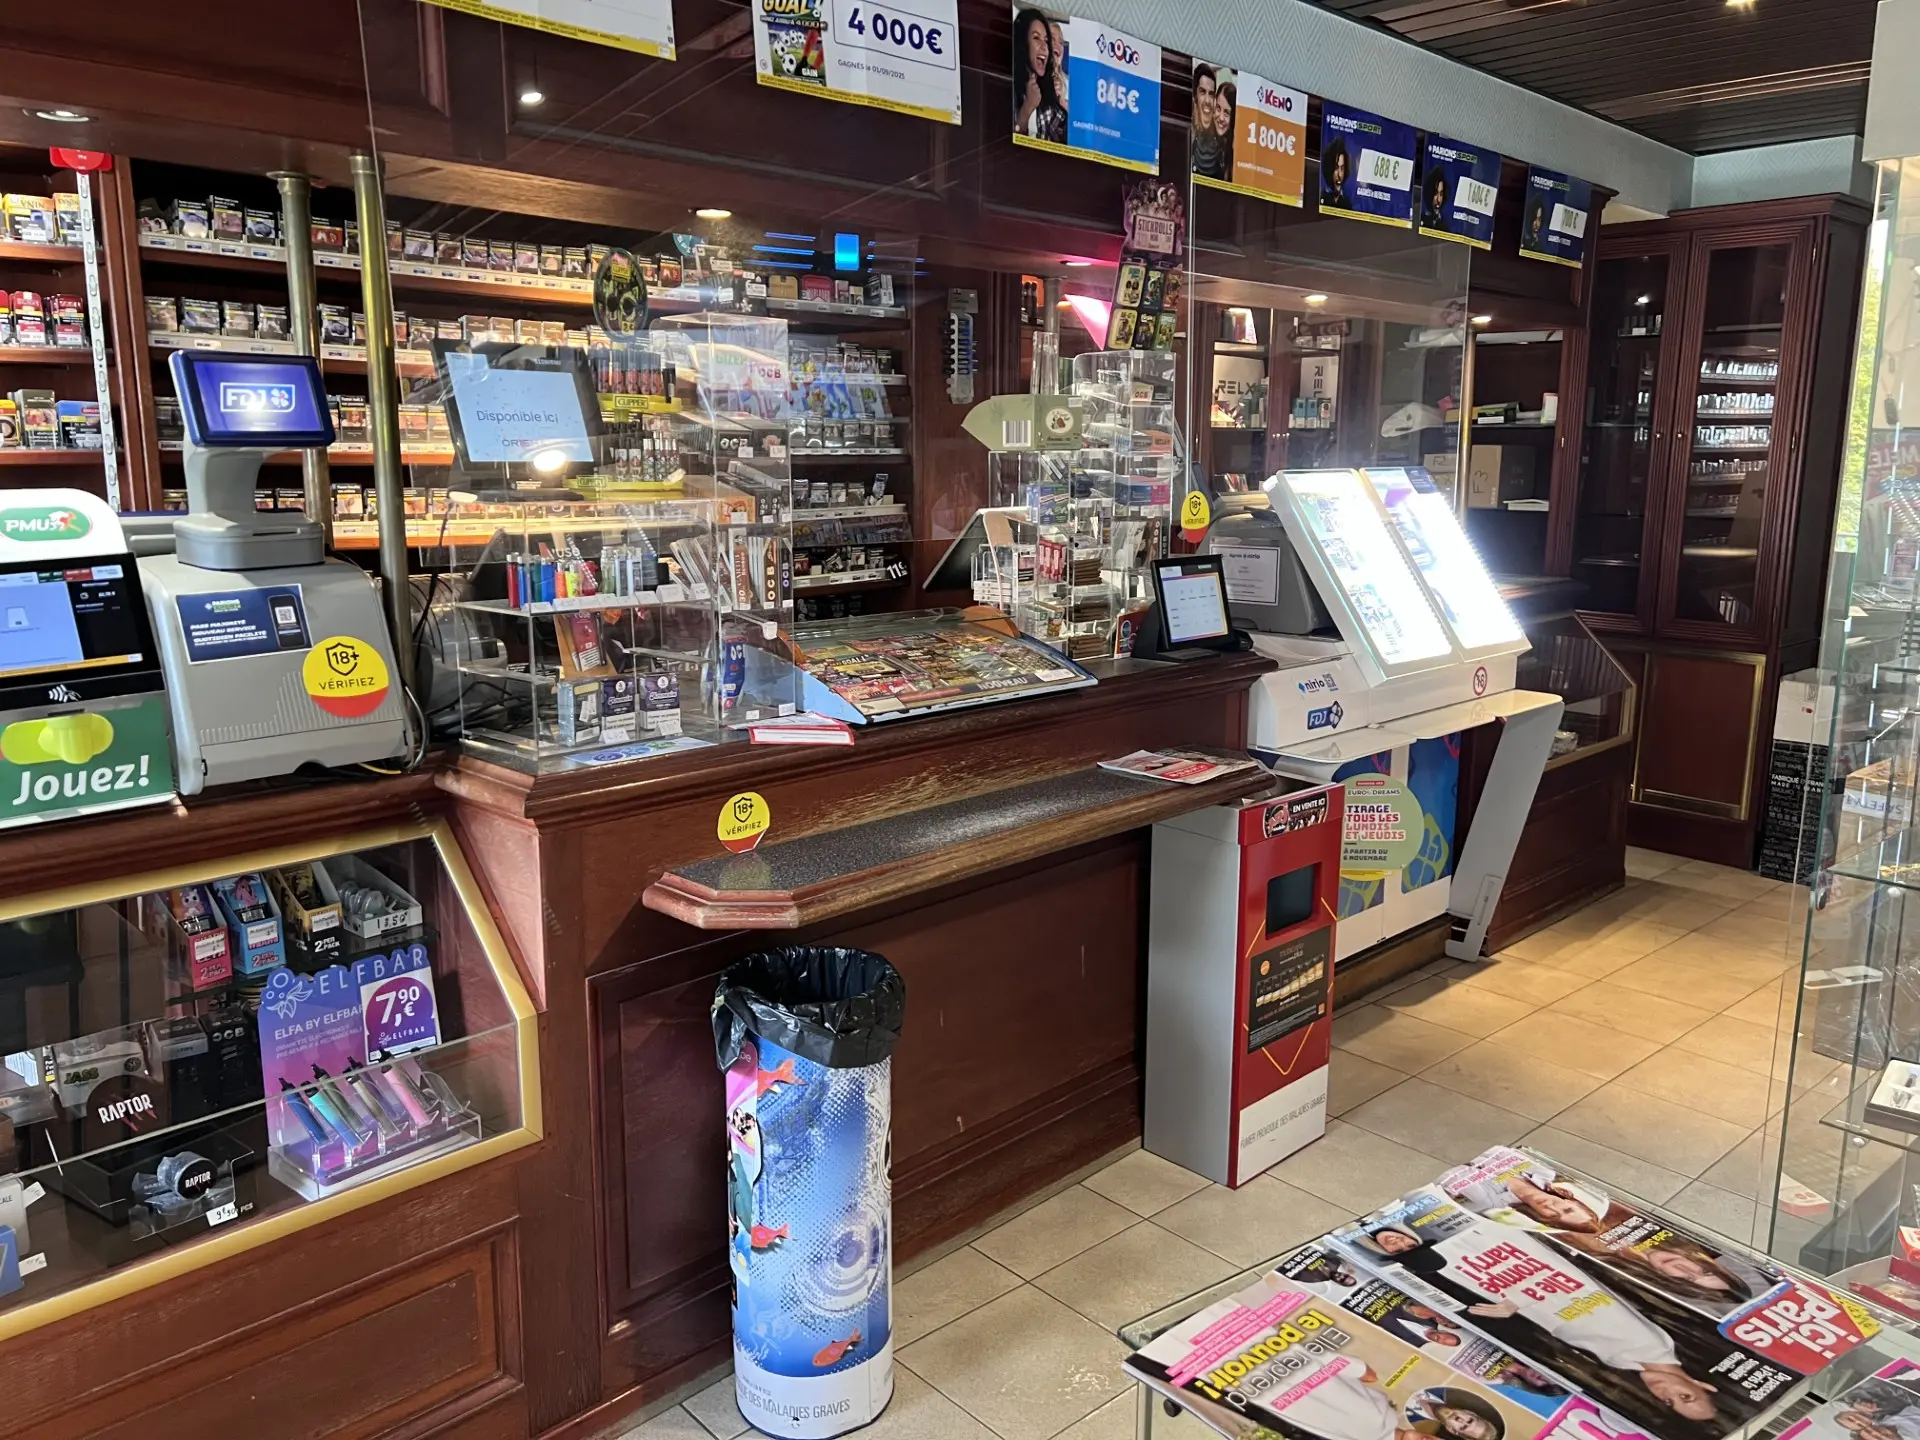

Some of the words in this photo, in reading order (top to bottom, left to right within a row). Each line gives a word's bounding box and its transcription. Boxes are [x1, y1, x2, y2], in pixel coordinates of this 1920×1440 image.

[848, 8, 865, 35] 4
[872, 13, 943, 54] 000€
[1108, 39, 1141, 65] LOTO
[801, 67, 818, 77] GAIN
[1097, 78, 1140, 114] 845€
[1331, 114, 1357, 130] PARIONS
[1247, 122, 1256, 144] 1
[1259, 125, 1296, 156] 800€
[1432, 145, 1456, 159] PARIONS
[1374, 155, 1391, 178] 688
[1392, 160, 1399, 180] €
[1138, 219, 1173, 235] STICKROLLS
[759, 367, 782, 379] OCB
[1217, 380, 1257, 396] RELX
[226, 388, 267, 408] FDJ
[617, 397, 648, 408] CLIPPER
[476, 410, 542, 425] Disponible
[544, 410, 559, 424] ici
[720, 437, 749, 449] OCB
[4, 518, 49, 533] PMU
[1184, 517, 1206, 525] VÉRIFIEZ
[766, 565, 776, 601] OCB
[782, 562, 790, 588] OCB
[191, 628, 225, 637] NOUVEAU
[226, 625, 256, 633] SERVICE
[331, 649, 360, 666] 18+
[318, 676, 376, 691] VÉRIFIEZ
[977, 676, 1028, 690] NOUVEAU
[1305, 677, 1325, 691] nirio
[1309, 710, 1326, 726] FDJ
[1771, 780, 1790, 788] MADE
[738, 802, 755, 814] 18+
[1292, 803, 1301, 813] EN
[1301, 801, 1317, 810] VENTE
[1318, 798, 1326, 806] ICI
[1347, 805, 1390, 814] TIRAGE
[1346, 814, 1376, 823] TOUS
[1379, 814, 1399, 822] LES
[1346, 822, 1390, 831] LUNDIS
[725, 820, 762, 836] VÉRIFIEZ
[1345, 831, 1359, 840] ET
[1362, 831, 1405, 840] JEUDIS
[1343, 847, 1349, 855] À
[314, 940, 323, 953] 2
[324, 936, 336, 944] PER
[323, 942, 340, 950] PACK
[252, 955, 261, 968] 2
[200, 967, 208, 981] 2
[320, 947, 425, 995] ELFBAR
[212, 1026, 245, 1042] OCB
[274, 1024, 304, 1041] ELFA
[305, 1016, 321, 1031] BY
[393, 1025, 426, 1041] ELFBAR
[65, 1066, 100, 1085] JASS
[98, 1093, 153, 1125] RAPTOR
[1240, 1135, 1256, 1149] FUMER
[1256, 1119, 1279, 1141] PROVOQUE
[1280, 1115, 1288, 1128] DES
[1288, 1101, 1310, 1125] MALADIES
[1310, 1092, 1327, 1113] GRAVES
[185, 1171, 212, 1189] RAPTOR
[1600, 1224, 1629, 1241] Nicolas
[1462, 1241, 1529, 1273] Harry
[1478, 1254, 1555, 1299] trompé
[1534, 1270, 1584, 1295] Elle
[1521, 1286, 1545, 1304] a
[1297, 1310, 1334, 1332] le
[1733, 1289, 1841, 1351] Paris
[1305, 1326, 1350, 1358] Elle
[1788, 1318, 1860, 1360] ici
[1208, 1323, 1305, 1390] pouvoir
[1306, 1358, 1347, 1386] Meghan
[1728, 1358, 1760, 1383] semaine
[1747, 1368, 1771, 1385] Paris
[1775, 1372, 1793, 1380] De
[1225, 1353, 1310, 1411] reprend
[1741, 1380, 1756, 1390] la
[1750, 1377, 1780, 1403] passage
[749, 1389, 762, 1408] DES
[762, 1398, 810, 1419] MALADIES
[813, 1398, 850, 1418] GRAVES
[1273, 1384, 1309, 1408] Markle
